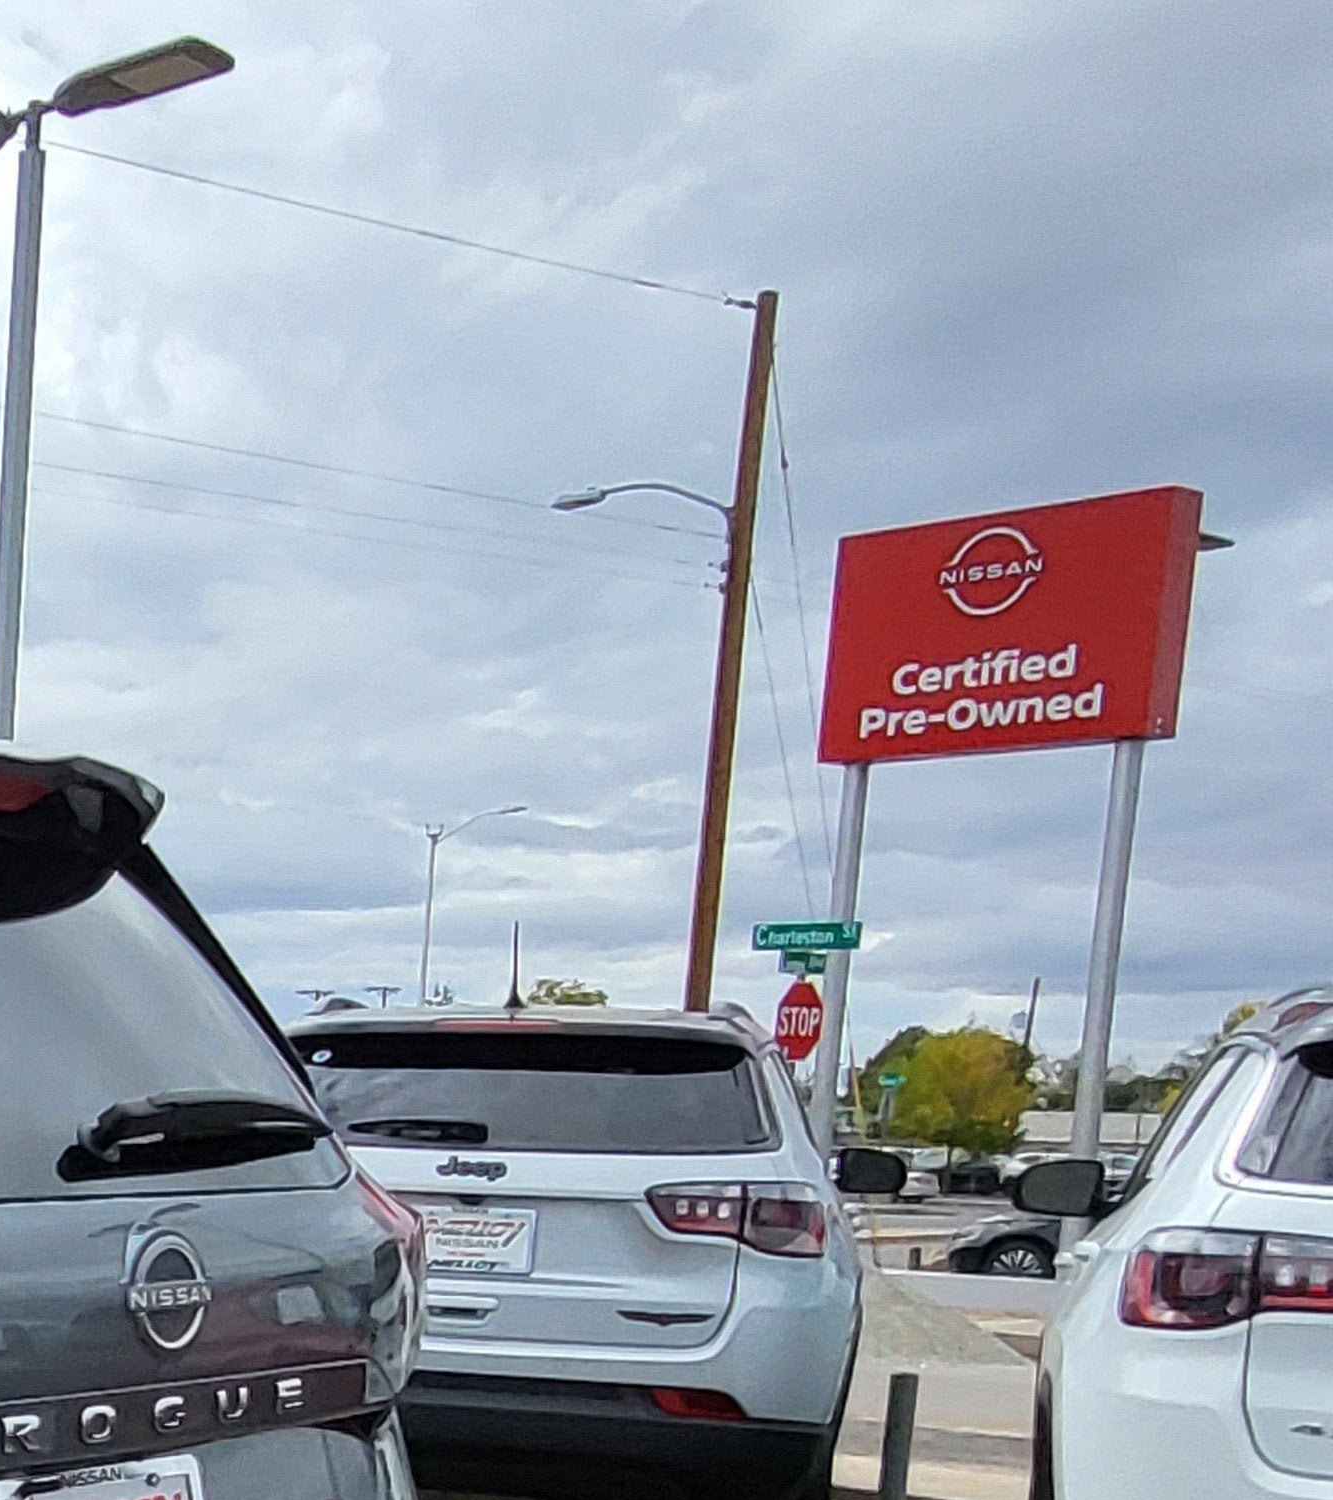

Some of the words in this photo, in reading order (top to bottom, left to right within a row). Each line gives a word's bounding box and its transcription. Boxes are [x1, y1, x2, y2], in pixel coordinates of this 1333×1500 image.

[938, 557, 1044, 585] NISSAN
[890, 642, 1078, 696] Certified
[857, 683, 1106, 740] Pre-Owned
[778, 1006, 821, 1037] STOP
[435, 1155, 508, 1182] Jeep
[129, 1284, 212, 1311] NISSAN
[1, 1378, 305, 1454] ROGUE
